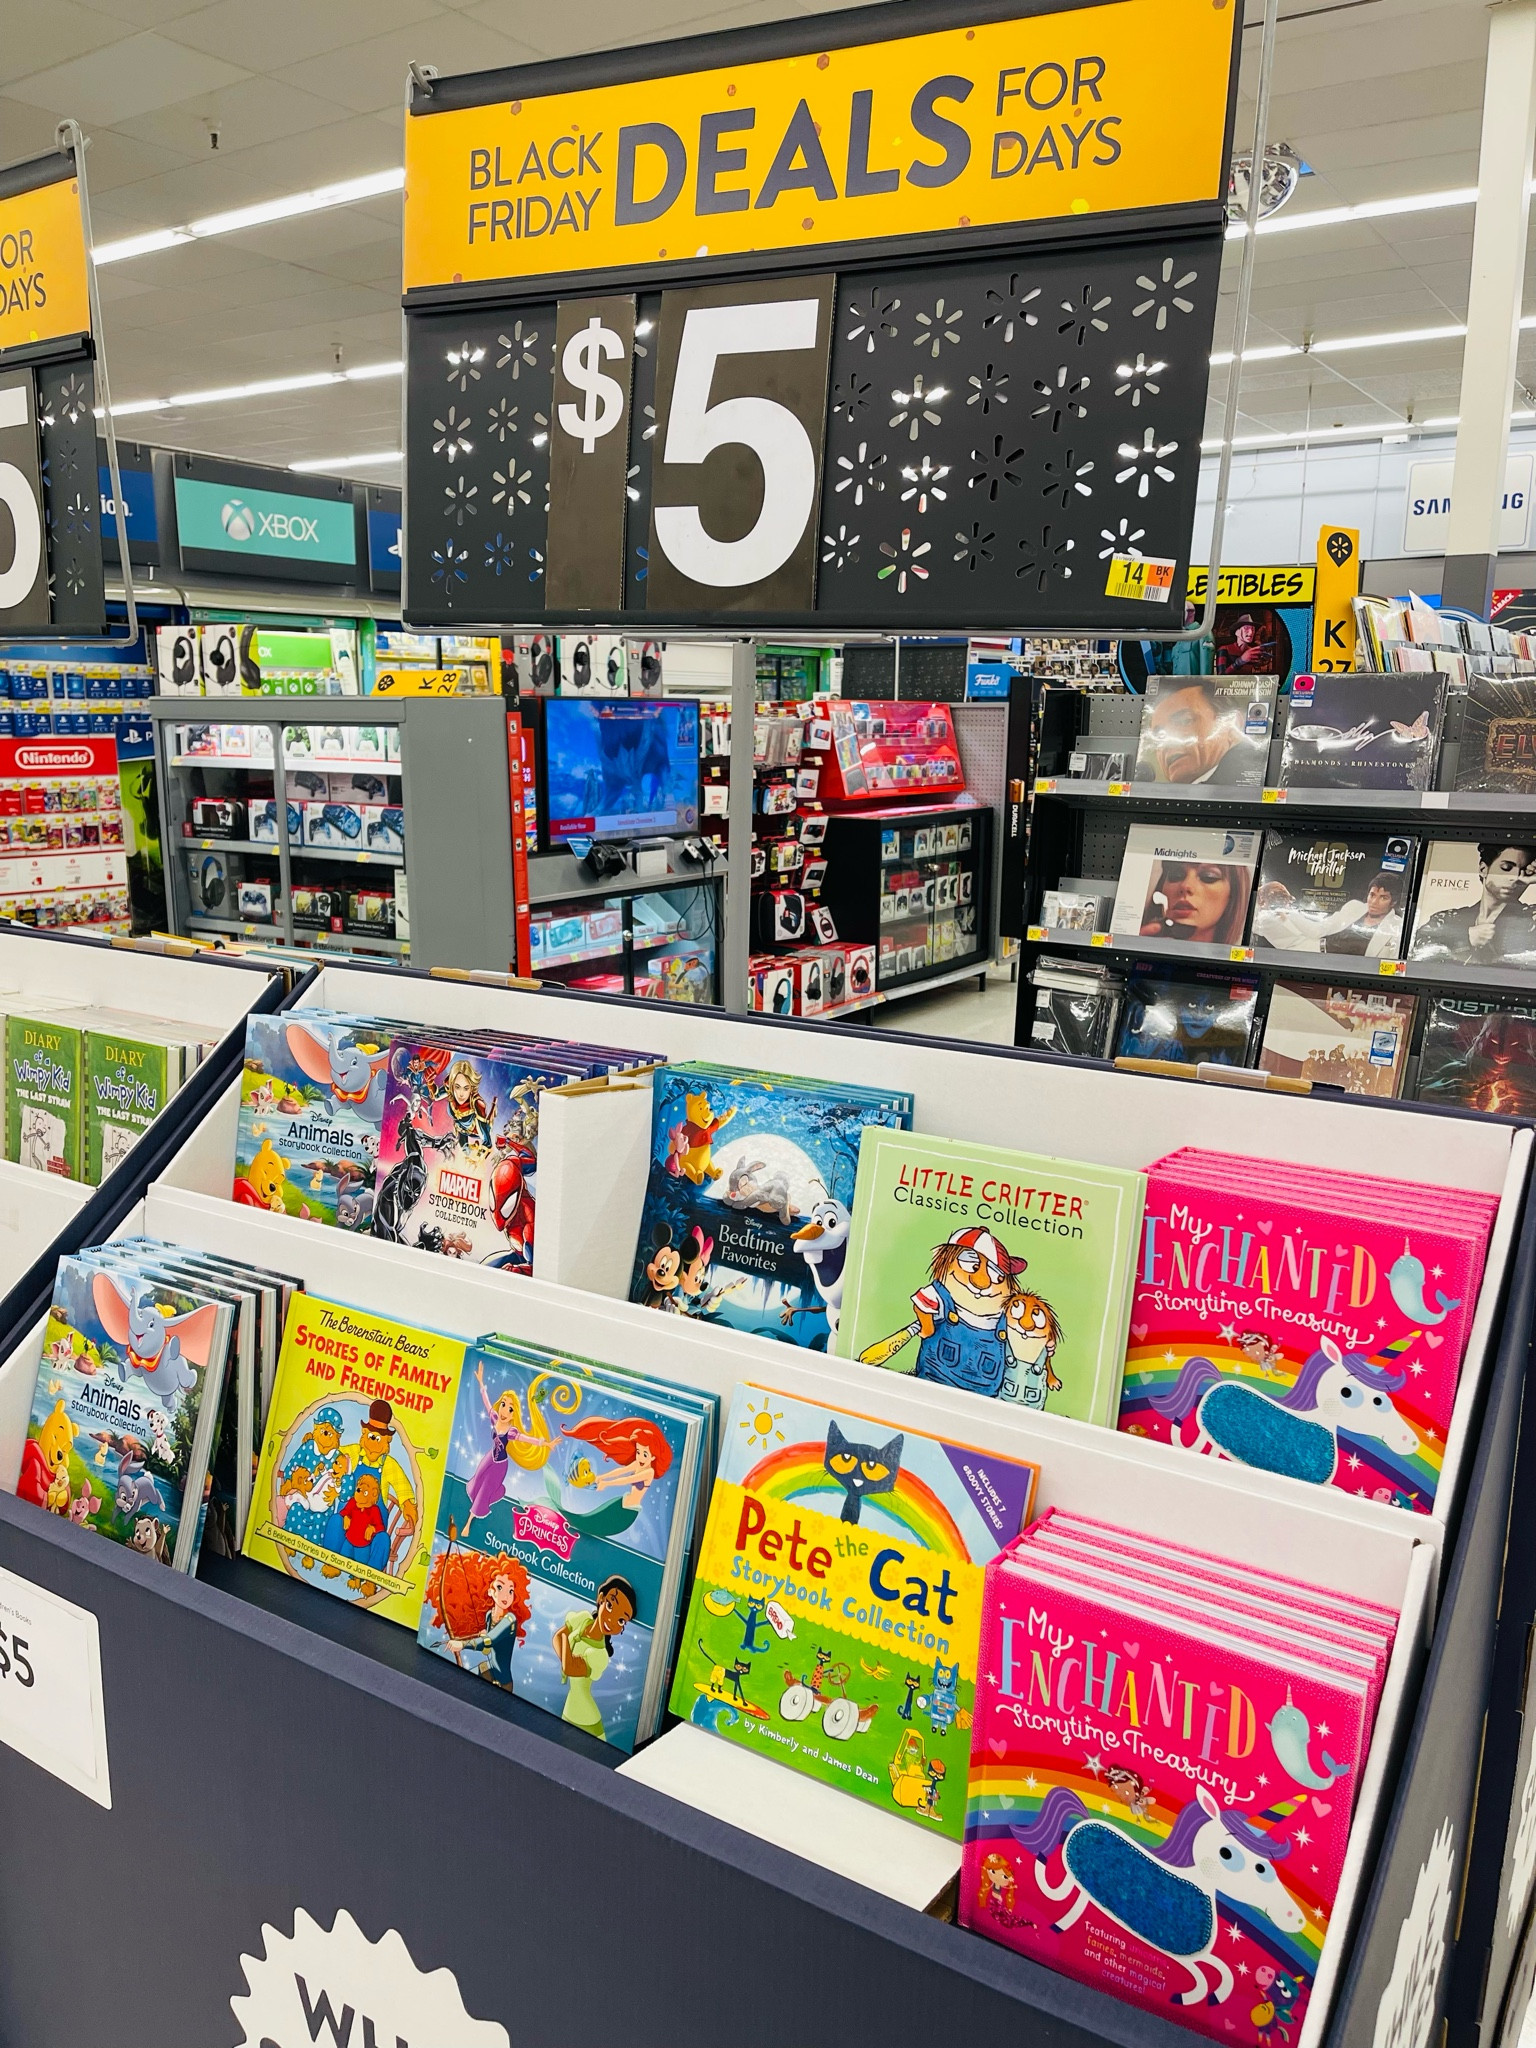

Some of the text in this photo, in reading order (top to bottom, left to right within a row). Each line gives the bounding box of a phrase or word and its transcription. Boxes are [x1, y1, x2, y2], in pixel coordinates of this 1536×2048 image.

[996, 55, 1106, 117] FOR
[470, 132, 604, 192] BLACK
[615, 74, 975, 228] DEALS
[990, 115, 1122, 180] DAYS
[468, 187, 602, 245] FRIDAY
[0, 229, 35, 270] OR
[257, 511, 320, 544] XBOX
[1123, 561, 1145, 585] 14
[1155, 565, 1171, 577] BK
[1184, 572, 1305, 598] ECTIBLES
[1324, 619, 1347, 649] K
[418, 676, 438, 690] K
[437, 672, 458, 694] 28
[22, 751, 88, 765] Nintendo
[1496, 734, 1536, 759] EL
[1010, 804, 1019, 838] DURACELL
[1153, 847, 1198, 859] Midnights
[1287, 846, 1366, 865] Michael Jackson
[1307, 860, 1347, 877] Thriller
[1430, 878, 1470, 889] PRINCE
[24, 1030, 61, 1051] DIARY
[34, 1049, 43, 1065] of
[105, 1045, 146, 1068] DIARY
[14, 1058, 72, 1093] Wimpy Kid
[115, 1065, 126, 1082] of
[15, 1088, 71, 1109] THE LAST STRAW
[93, 1075, 157, 1112] Wimpy Kid
[96, 1105, 153, 1126] THE LAST STRA
[309, 1110, 333, 1127] Disney
[287, 1121, 354, 1147] Animals
[321, 1145, 362, 1160] Collection
[439, 1170, 480, 1203] MARVEL
[899, 1163, 974, 1199] LITTLE
[428, 1193, 488, 1221] STORYBOOK
[434, 1209, 478, 1229] COLLECTION
[893, 1186, 1084, 1240] Classics Collection
[1169, 1202, 1213, 1245] My
[718, 1223, 785, 1256] Bedtime
[720, 1245, 777, 1272] Favorites
[1140, 1215, 1377, 1317] ENCHANTED
[319, 1309, 338, 1331] The
[338, 1315, 393, 1348] Berenstain
[1137, 1290, 1375, 1349] Storytime Treasury
[294, 1324, 452, 1394] STORIES OF FAMILY
[80, 1382, 142, 1421] Animals
[305, 1358, 434, 1414] AND FRIENDSHIP
[109, 1414, 147, 1438] Collection
[962, 1464, 1004, 1531] GROOVY STORIES!
[976, 1468, 1003, 1507] INCLUDES
[518, 1516, 570, 1553] PRINCESS
[533, 1508, 560, 1533] Disney
[272, 1529, 297, 1546] Beloved
[296, 1538, 320, 1557] Stories
[320, 1550, 329, 1562] by
[329, 1553, 346, 1568] Stan
[352, 1562, 366, 1576] Jan
[366, 1570, 401, 1590] Berenstain
[484, 1531, 596, 1592] Storybook Collection
[734, 1495, 959, 1626] Pete the Cat
[15, 1610, 32, 1626] Books
[730, 1555, 950, 1655] Storybook Collection
[767, 1606, 784, 1631] BREAD
[1027, 1606, 1075, 1658] My
[998, 1616, 1257, 1766] ENCHANTED
[744, 1718, 880, 1785] by Kimberly and James Dean
[995, 1702, 1256, 1806] Storytime Treasury
[1084, 1920, 1127, 1951] Featuring
[1083, 1948, 1167, 1992] and other magical
